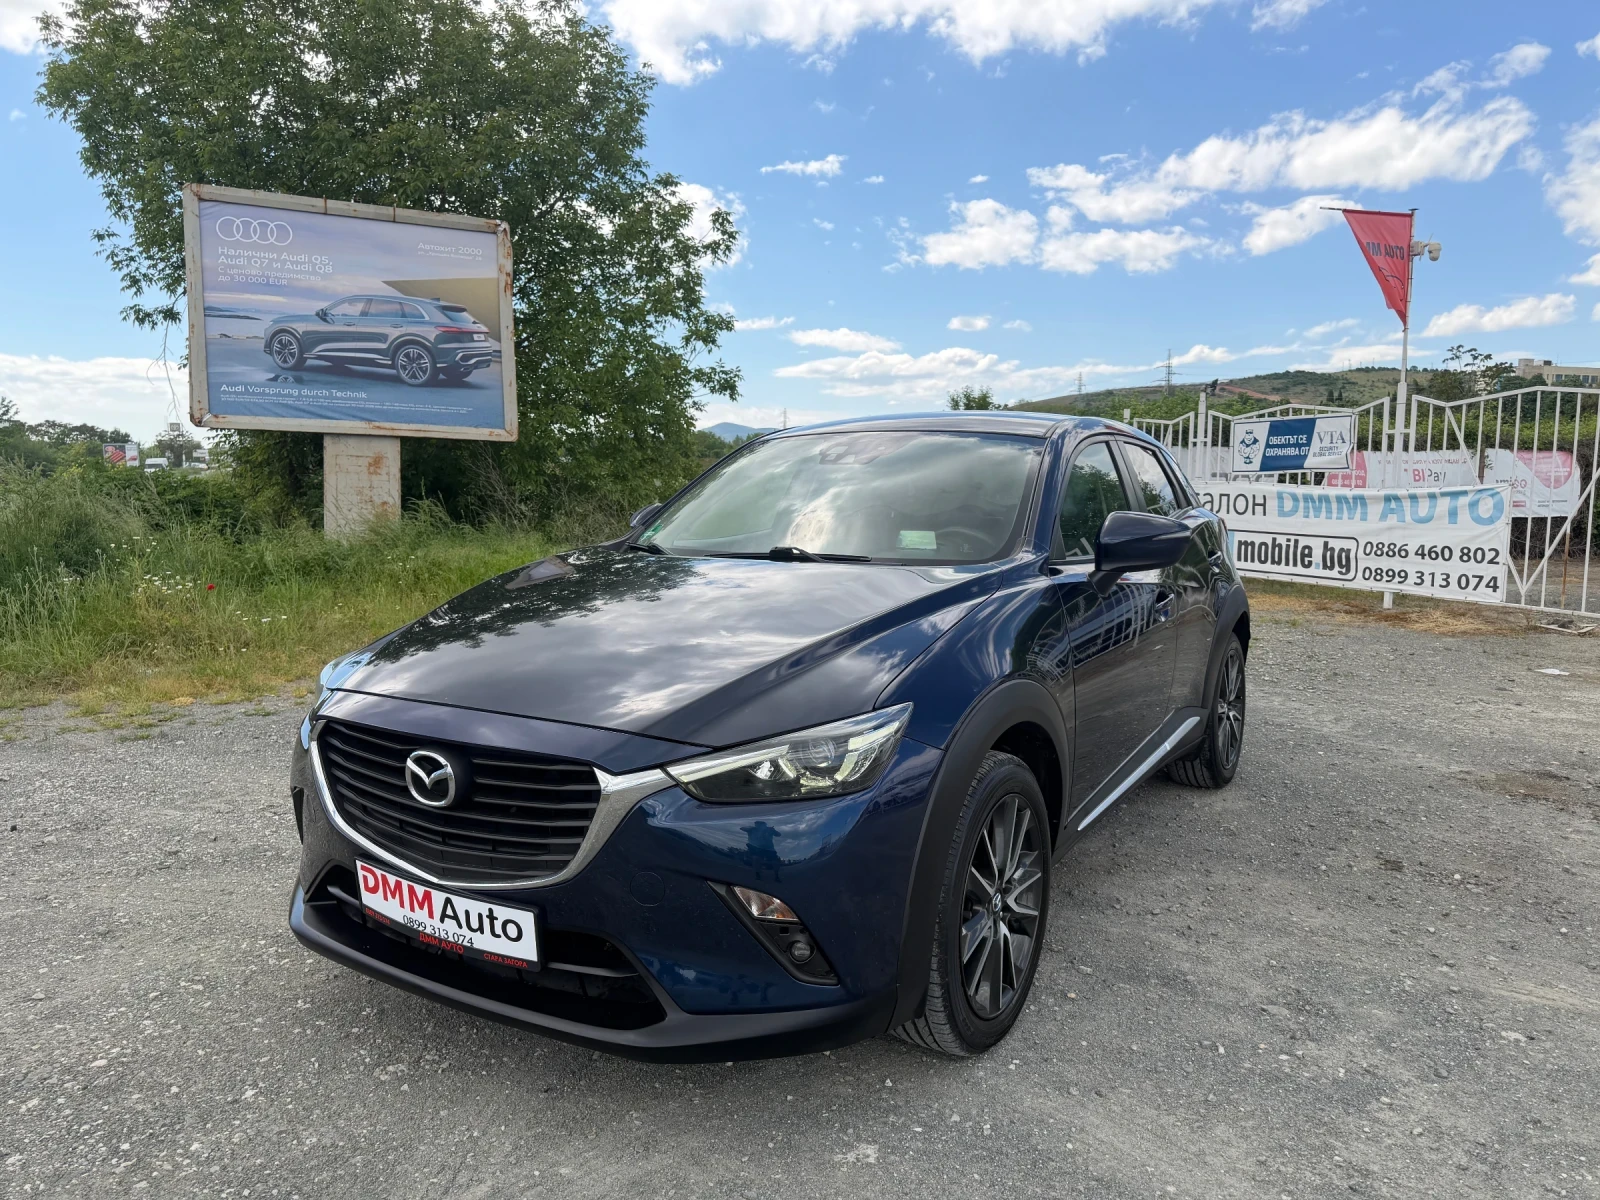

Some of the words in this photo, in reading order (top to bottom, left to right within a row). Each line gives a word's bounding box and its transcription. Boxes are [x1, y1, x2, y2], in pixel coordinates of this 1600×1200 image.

[218, 246, 277, 259] Налични
[281, 252, 308, 262] Audi
[312, 256, 333, 265] Q5,
[418, 242, 456, 252] Автохит
[459, 247, 482, 255] 2000
[1384, 244, 1404, 260] AUTO
[218, 256, 247, 265] Audi
[252, 258, 268, 267] Q7
[285, 262, 312, 271] Audi
[316, 264, 333, 273] Q8
[228, 268, 262, 276] ценово
[265, 271, 321, 281] предимство
[221, 384, 244, 392] Audi
[247, 386, 298, 396] Vorsprung
[301, 388, 328, 397] durch
[331, 390, 367, 398] Technik
[1269, 436, 1297, 444] ОБЕКТЪТ
[1299, 435, 1307, 443] СЕ
[1316, 431, 1346, 444] VTA
[1266, 447, 1299, 456] ОХРАНЯВА
[1301, 447, 1309, 455] ОТ
[1196, 492, 1266, 516] алон
[1277, 489, 1368, 522] DMM
[1378, 488, 1505, 526] AUTO
[1237, 537, 1351, 575] mobile.bg
[1363, 541, 1409, 558] 0886
[1414, 544, 1453, 561] 460
[1459, 546, 1500, 565] 802
[1362, 566, 1408, 584] 0899
[1414, 571, 1450, 588] 313
[1457, 574, 1499, 592] 074
[360, 864, 434, 920] DMM
[440, 897, 523, 942] Auto
[402, 915, 426, 932] 0899
[430, 925, 450, 940] 313
[452, 932, 474, 946] 074
[420, 932, 439, 945] ДММ
[441, 941, 464, 954] АУТО
[484, 953, 503, 962] СТАРА
[504, 958, 527, 968] ЗАГОРА
